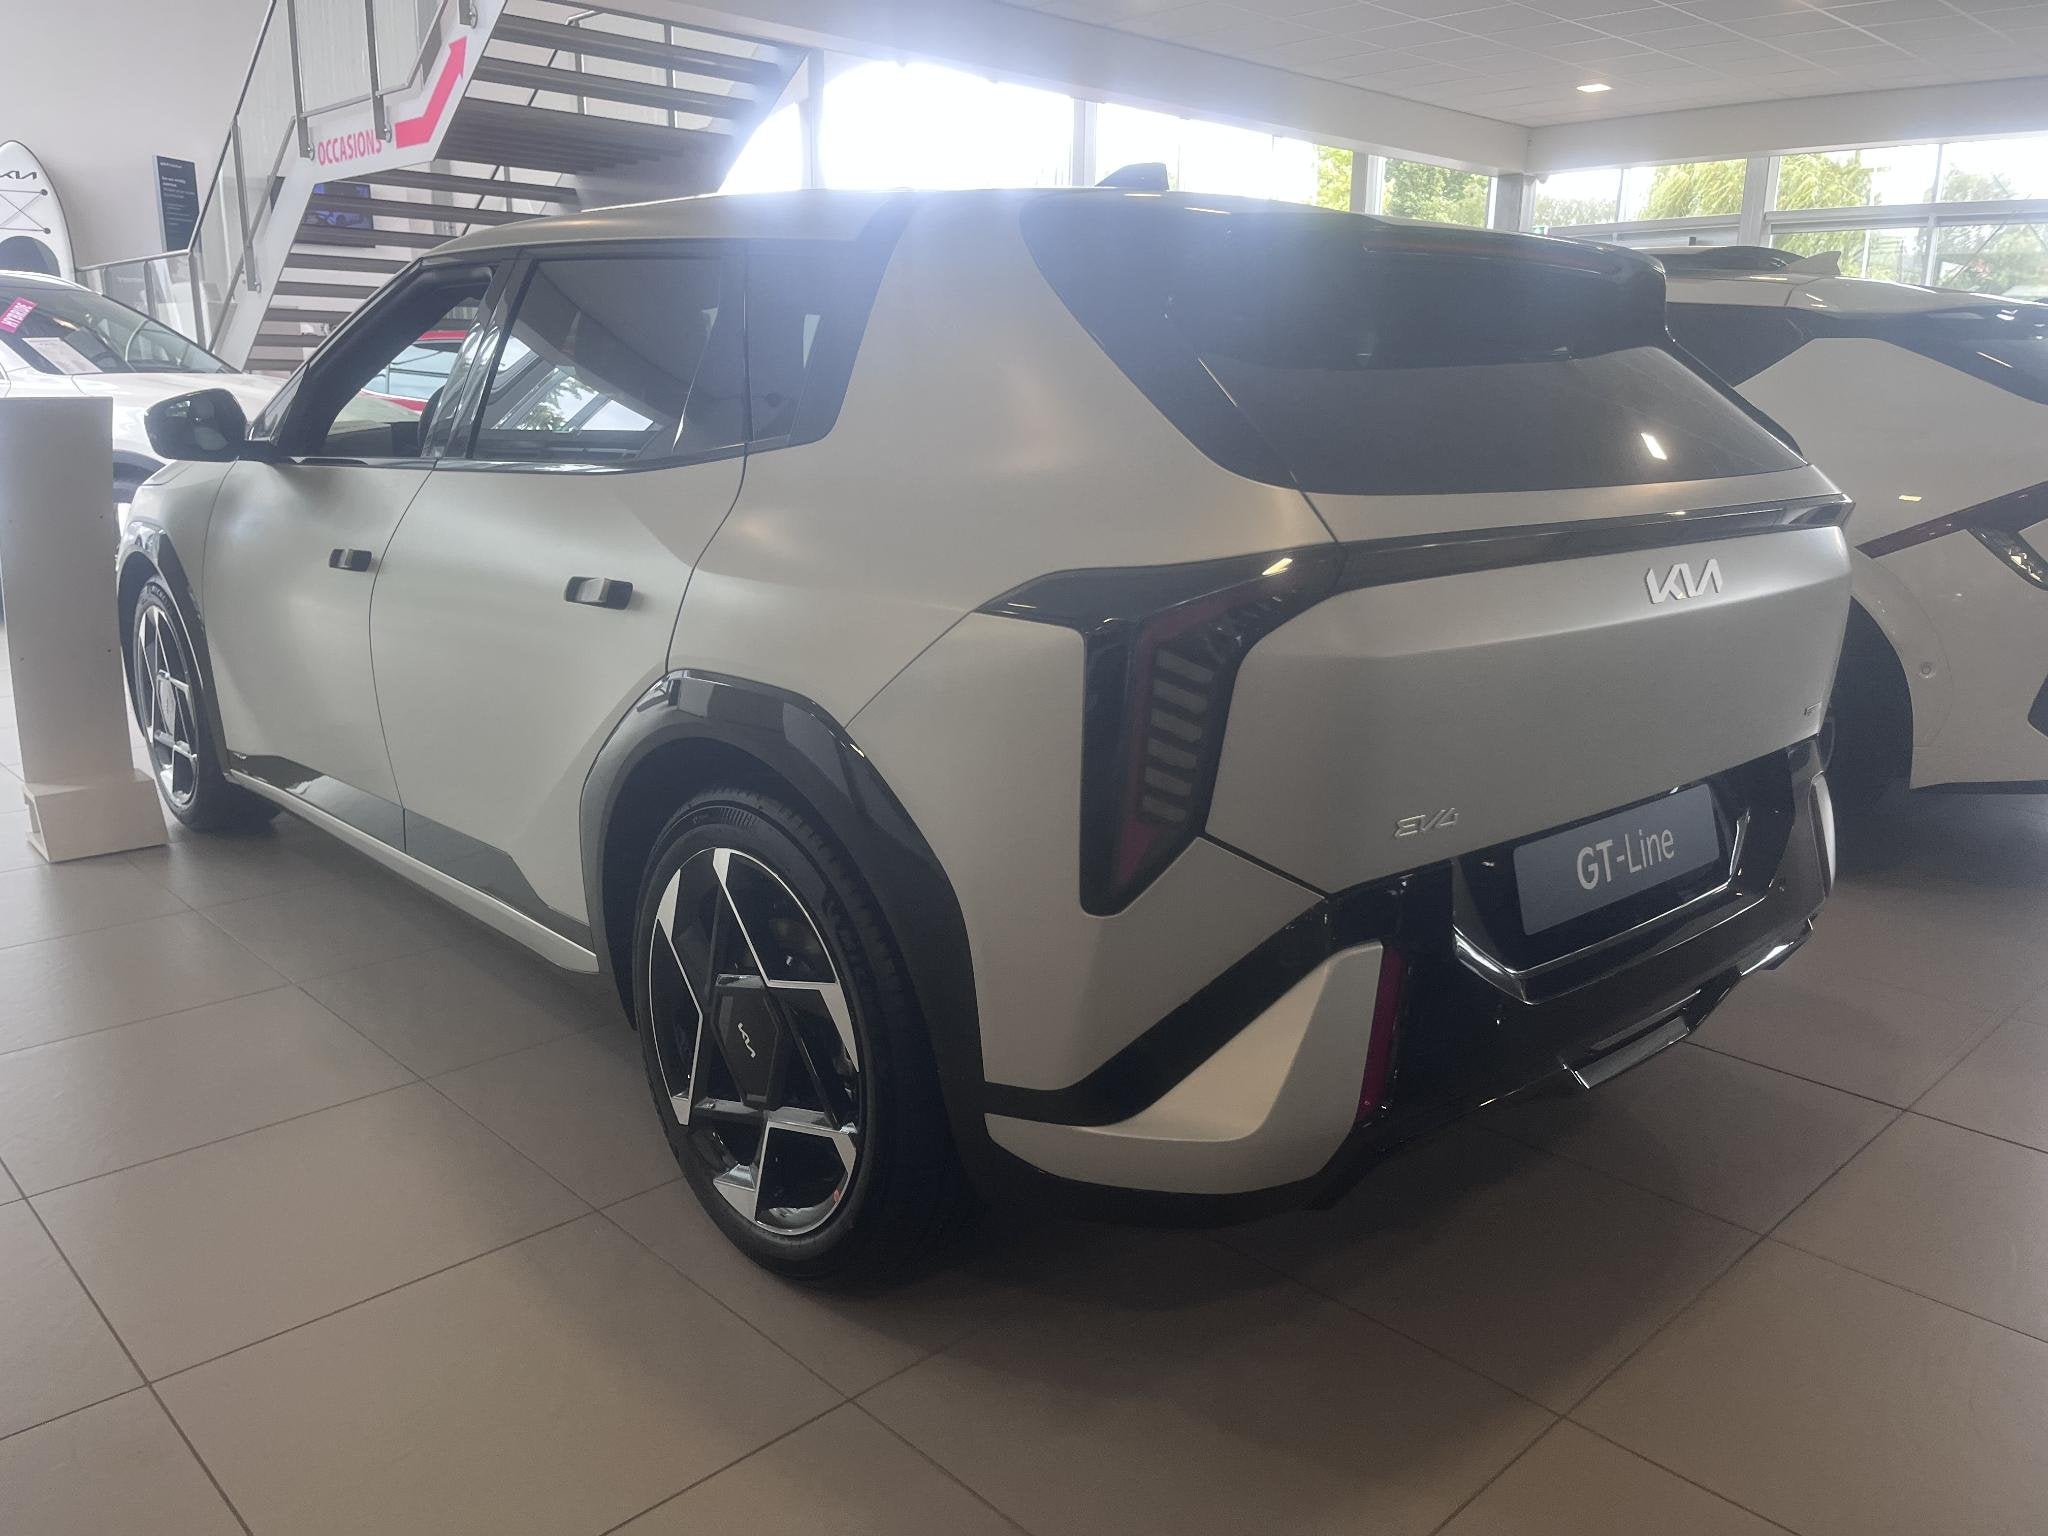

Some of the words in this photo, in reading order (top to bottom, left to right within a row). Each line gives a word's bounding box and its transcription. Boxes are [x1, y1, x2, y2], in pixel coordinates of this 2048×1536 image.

[317, 129, 382, 166] OCCASIONS
[1644, 558, 1723, 604] KIA
[1576, 828, 1675, 890] GT-Line
